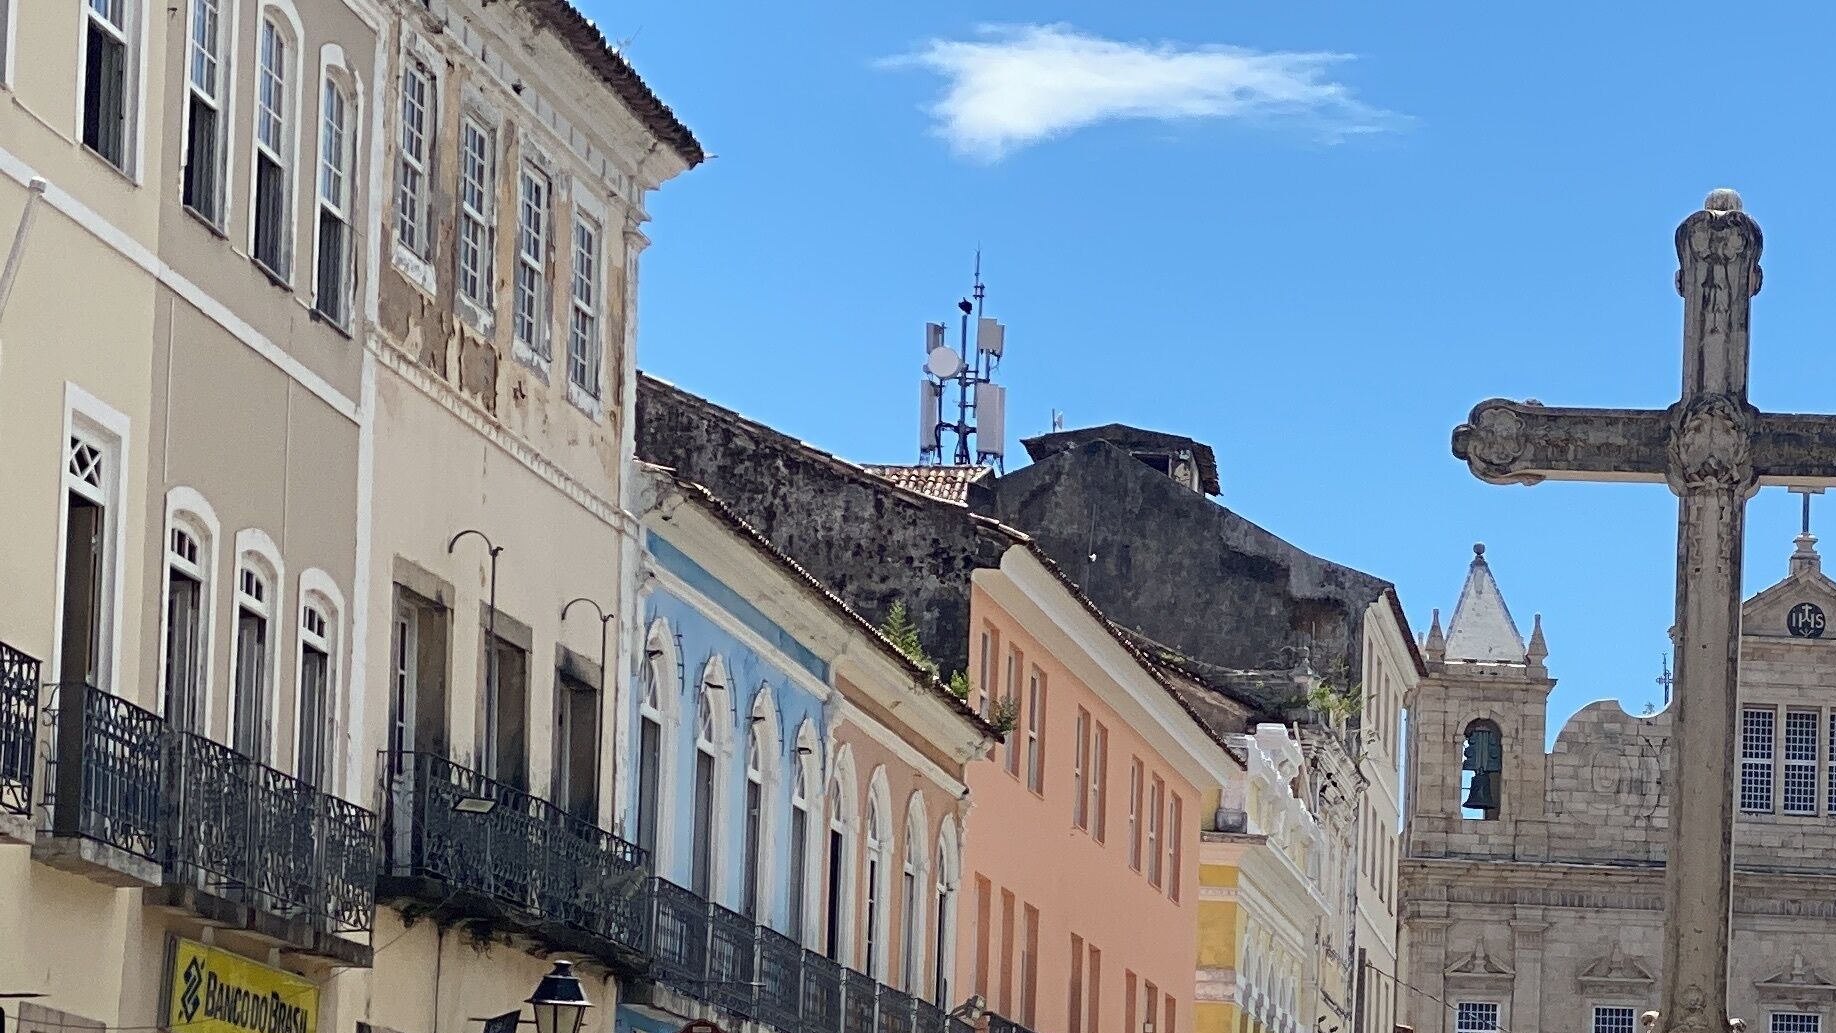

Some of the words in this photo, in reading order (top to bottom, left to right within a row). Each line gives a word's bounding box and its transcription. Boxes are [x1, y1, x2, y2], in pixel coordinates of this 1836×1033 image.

[1792, 612, 1825, 628] IHS
[204, 970, 250, 1029] BANCO
[250, 992, 269, 1033] DO
